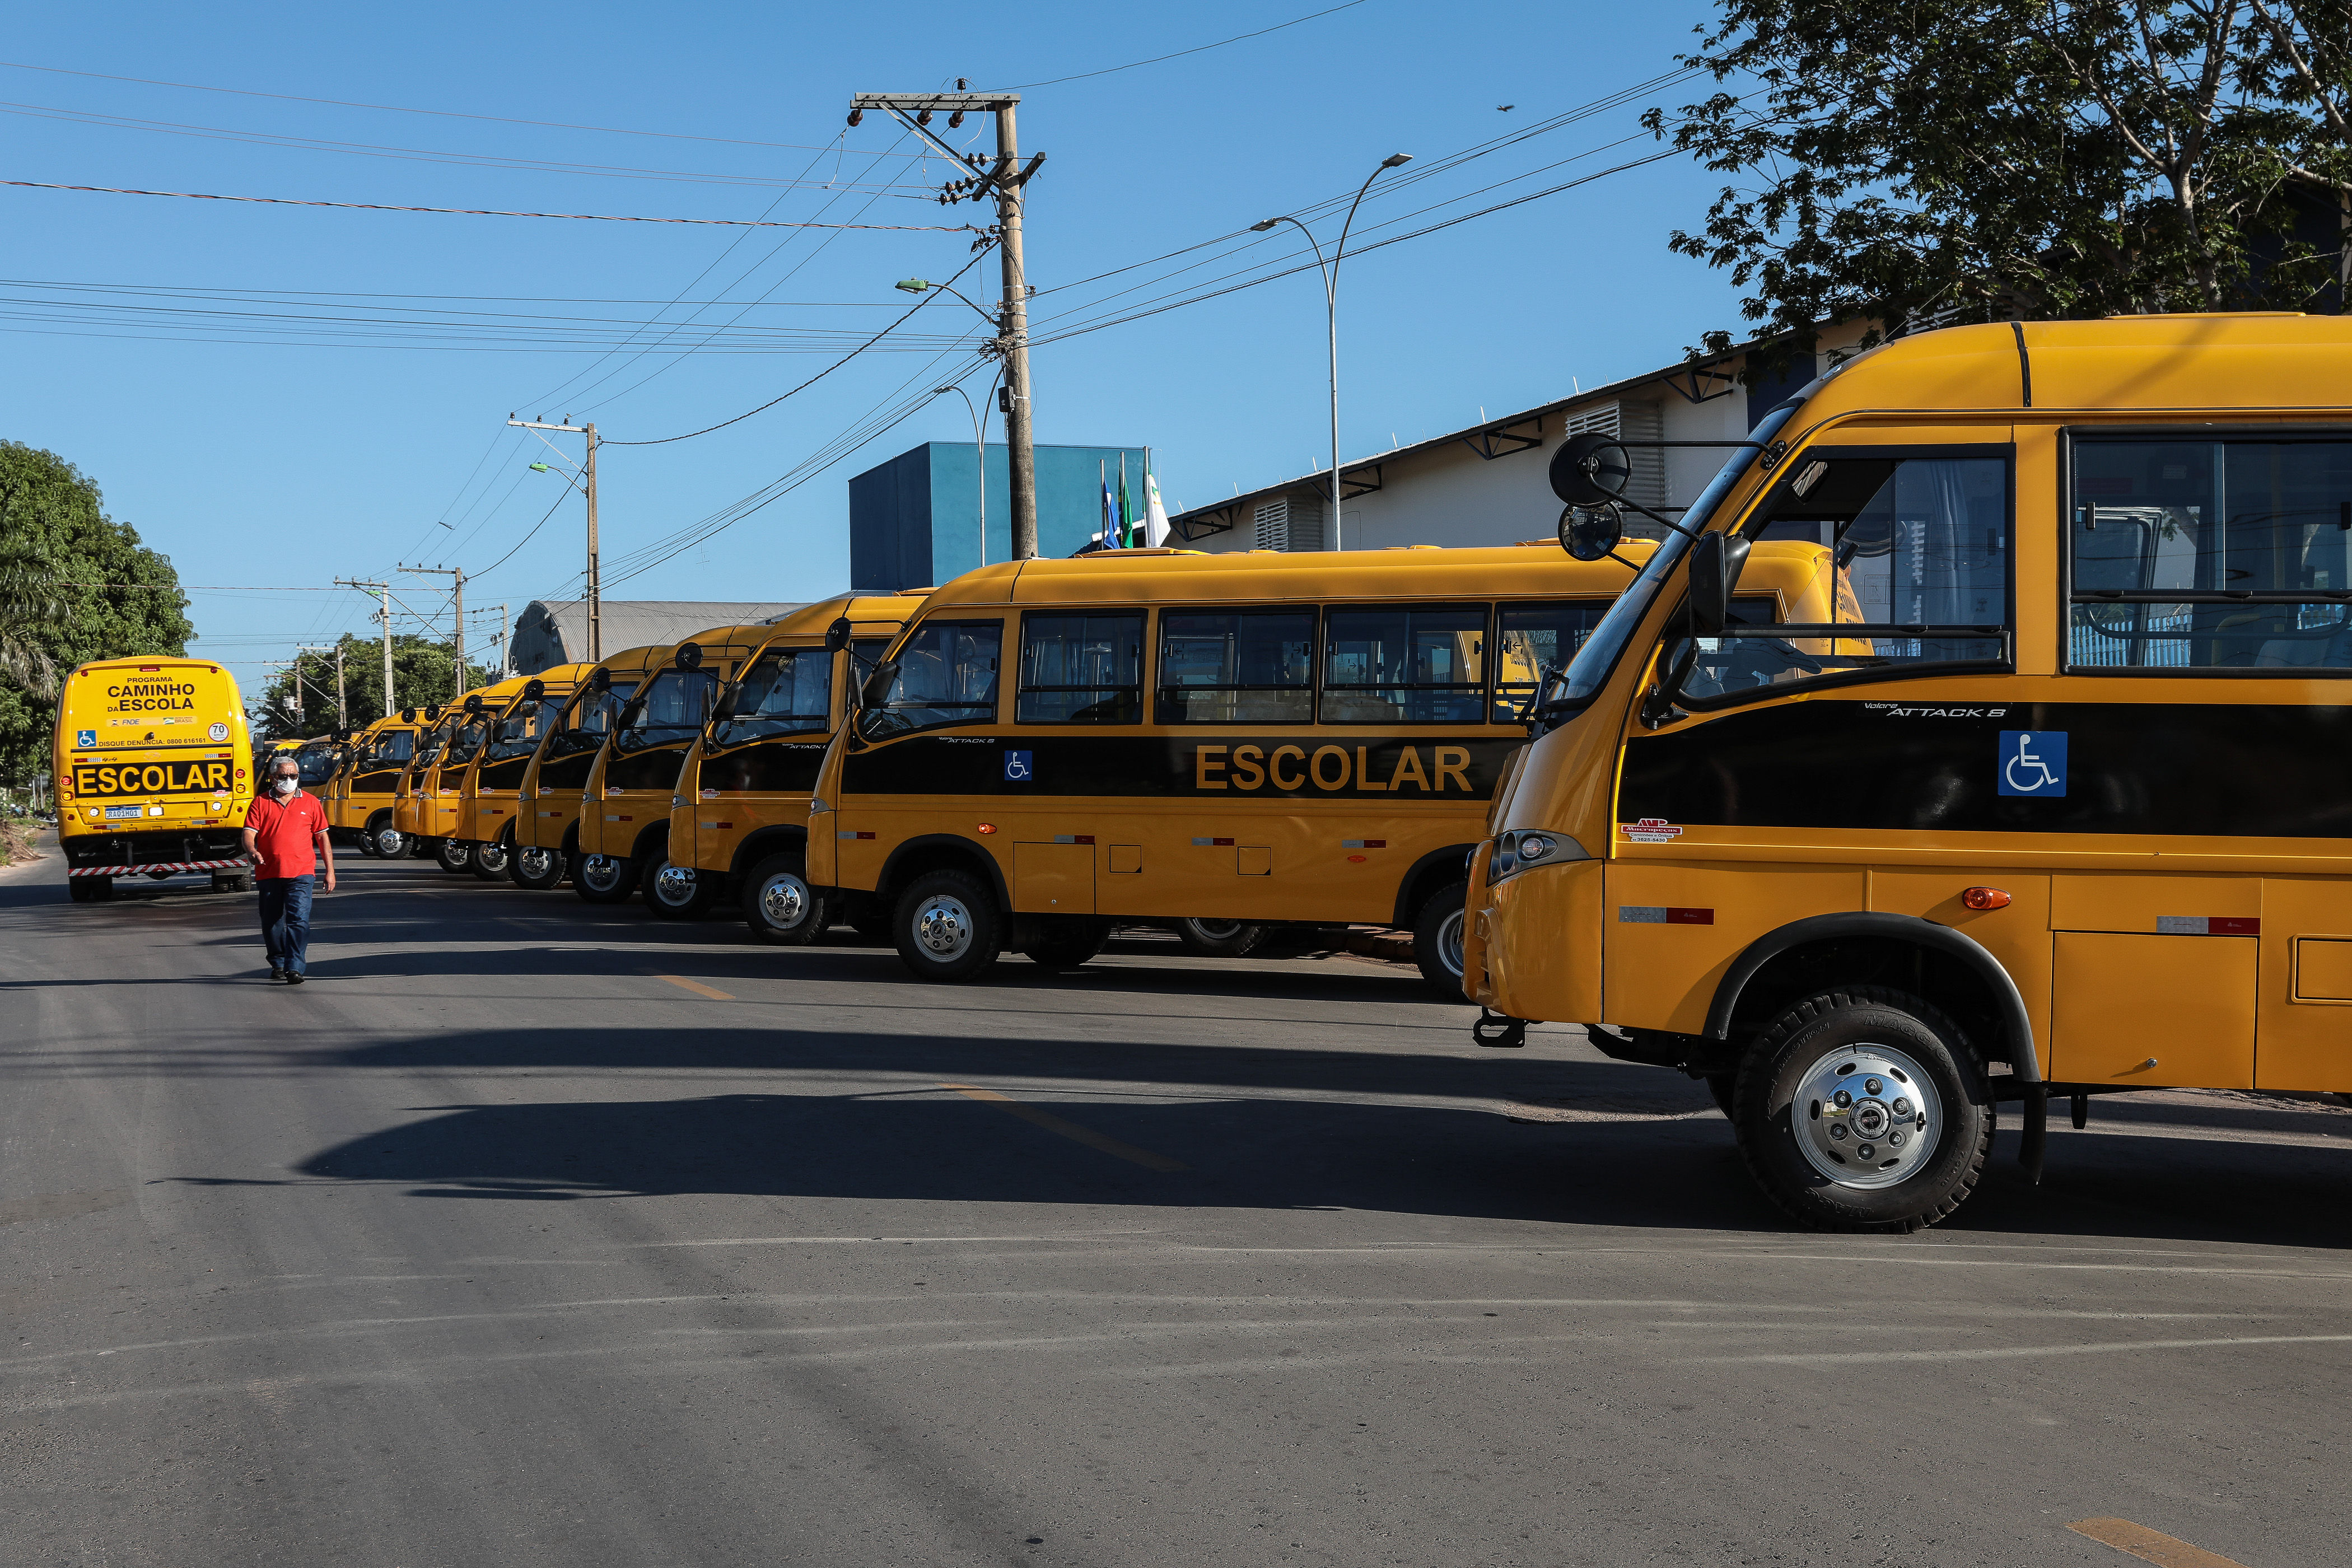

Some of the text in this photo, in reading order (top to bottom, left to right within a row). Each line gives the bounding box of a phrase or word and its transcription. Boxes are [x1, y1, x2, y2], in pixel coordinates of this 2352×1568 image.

[108, 683, 195, 698] CAMINHO
[119, 697, 194, 711] ESCOLA
[1886, 708, 2006, 717] ATTACK 8
[1196, 745, 1473, 791] ESCOLAR
[77, 764, 229, 794] ESCOLAR
